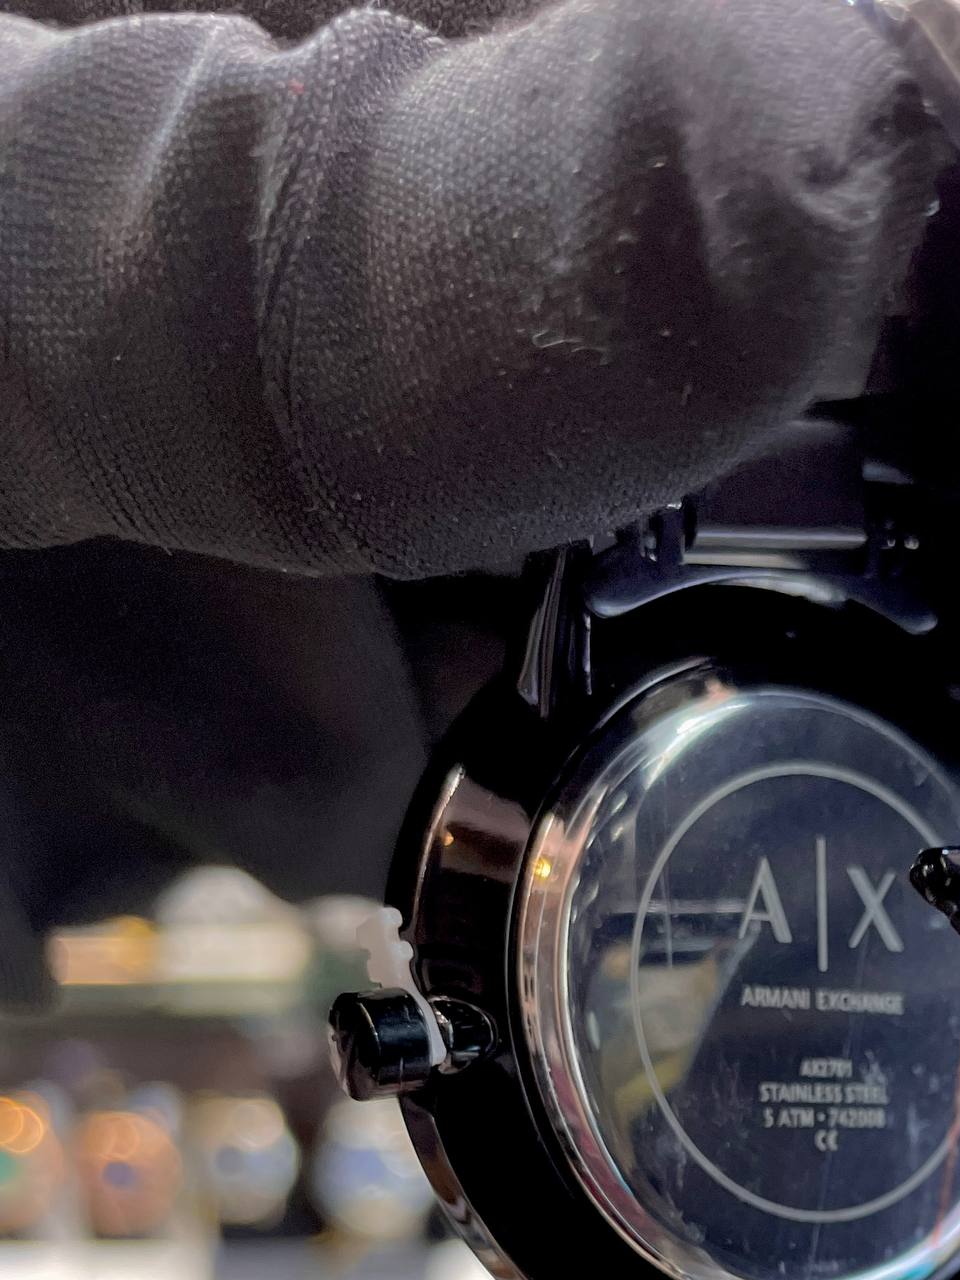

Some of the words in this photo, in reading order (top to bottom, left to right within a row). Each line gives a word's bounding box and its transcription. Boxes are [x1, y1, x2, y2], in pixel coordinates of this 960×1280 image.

[741, 986, 811, 1009] ARMANI
[815, 990, 905, 1015] EXCHANGE
[759, 1082, 842, 1103] STAINLESS
[777, 1107, 815, 1128] ATM
